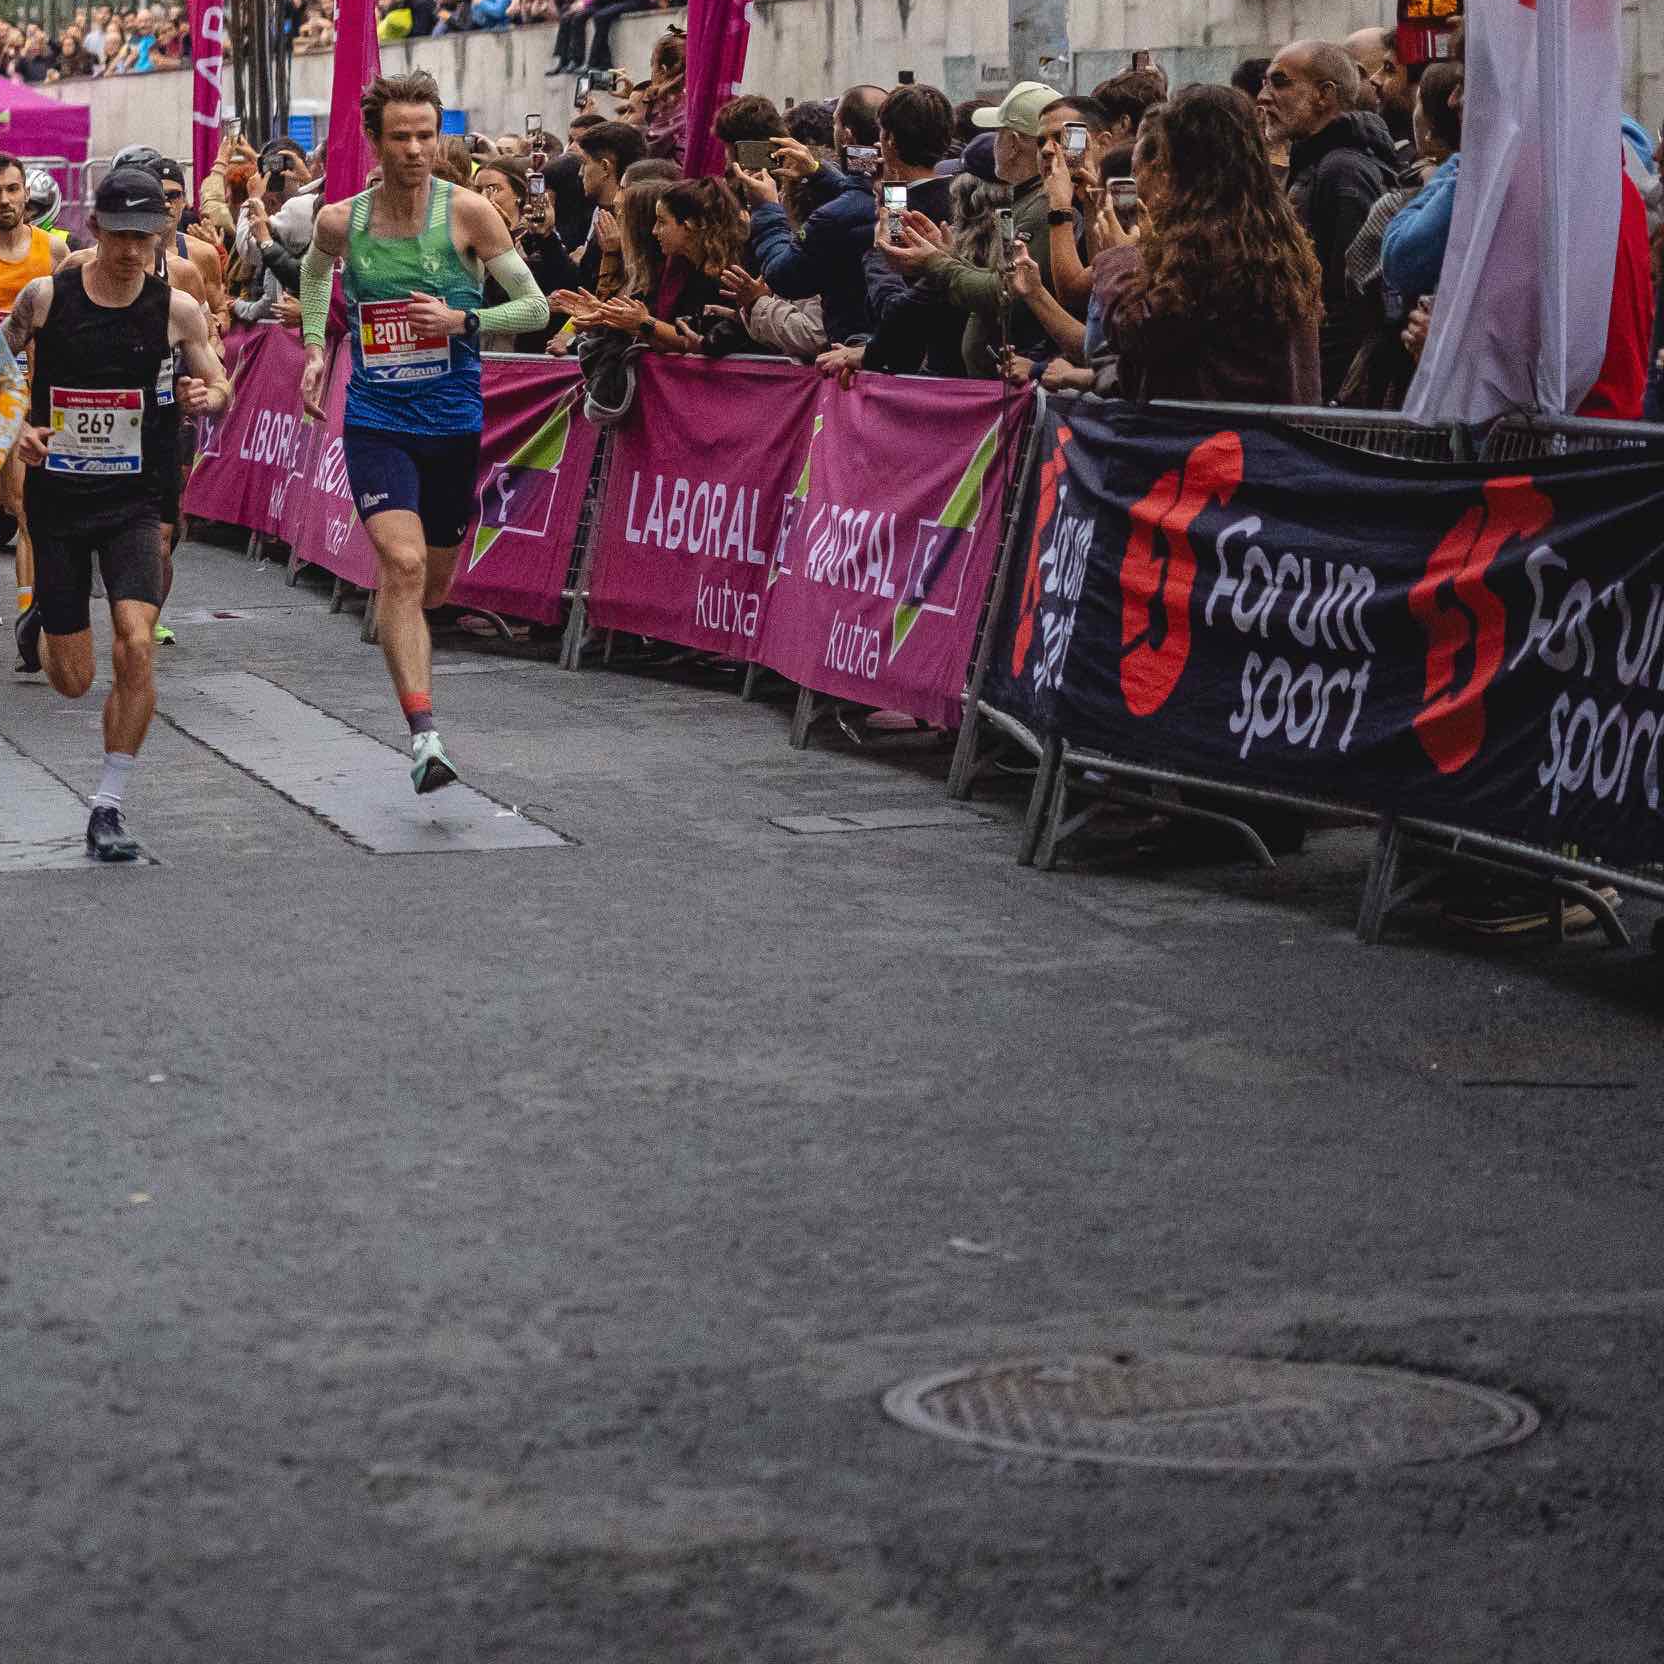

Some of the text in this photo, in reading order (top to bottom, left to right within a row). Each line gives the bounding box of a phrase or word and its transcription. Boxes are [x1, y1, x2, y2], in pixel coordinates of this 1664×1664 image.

[374, 320, 425, 345] 2010
[77, 413, 115, 435] 269
[626, 470, 770, 567] LABORAL
[805, 502, 898, 600] LABORAL
[695, 573, 760, 638] kutxa
[1205, 515, 1376, 654] Forum
[825, 608, 881, 681] kutxa
[1228, 650, 1372, 760] sport
